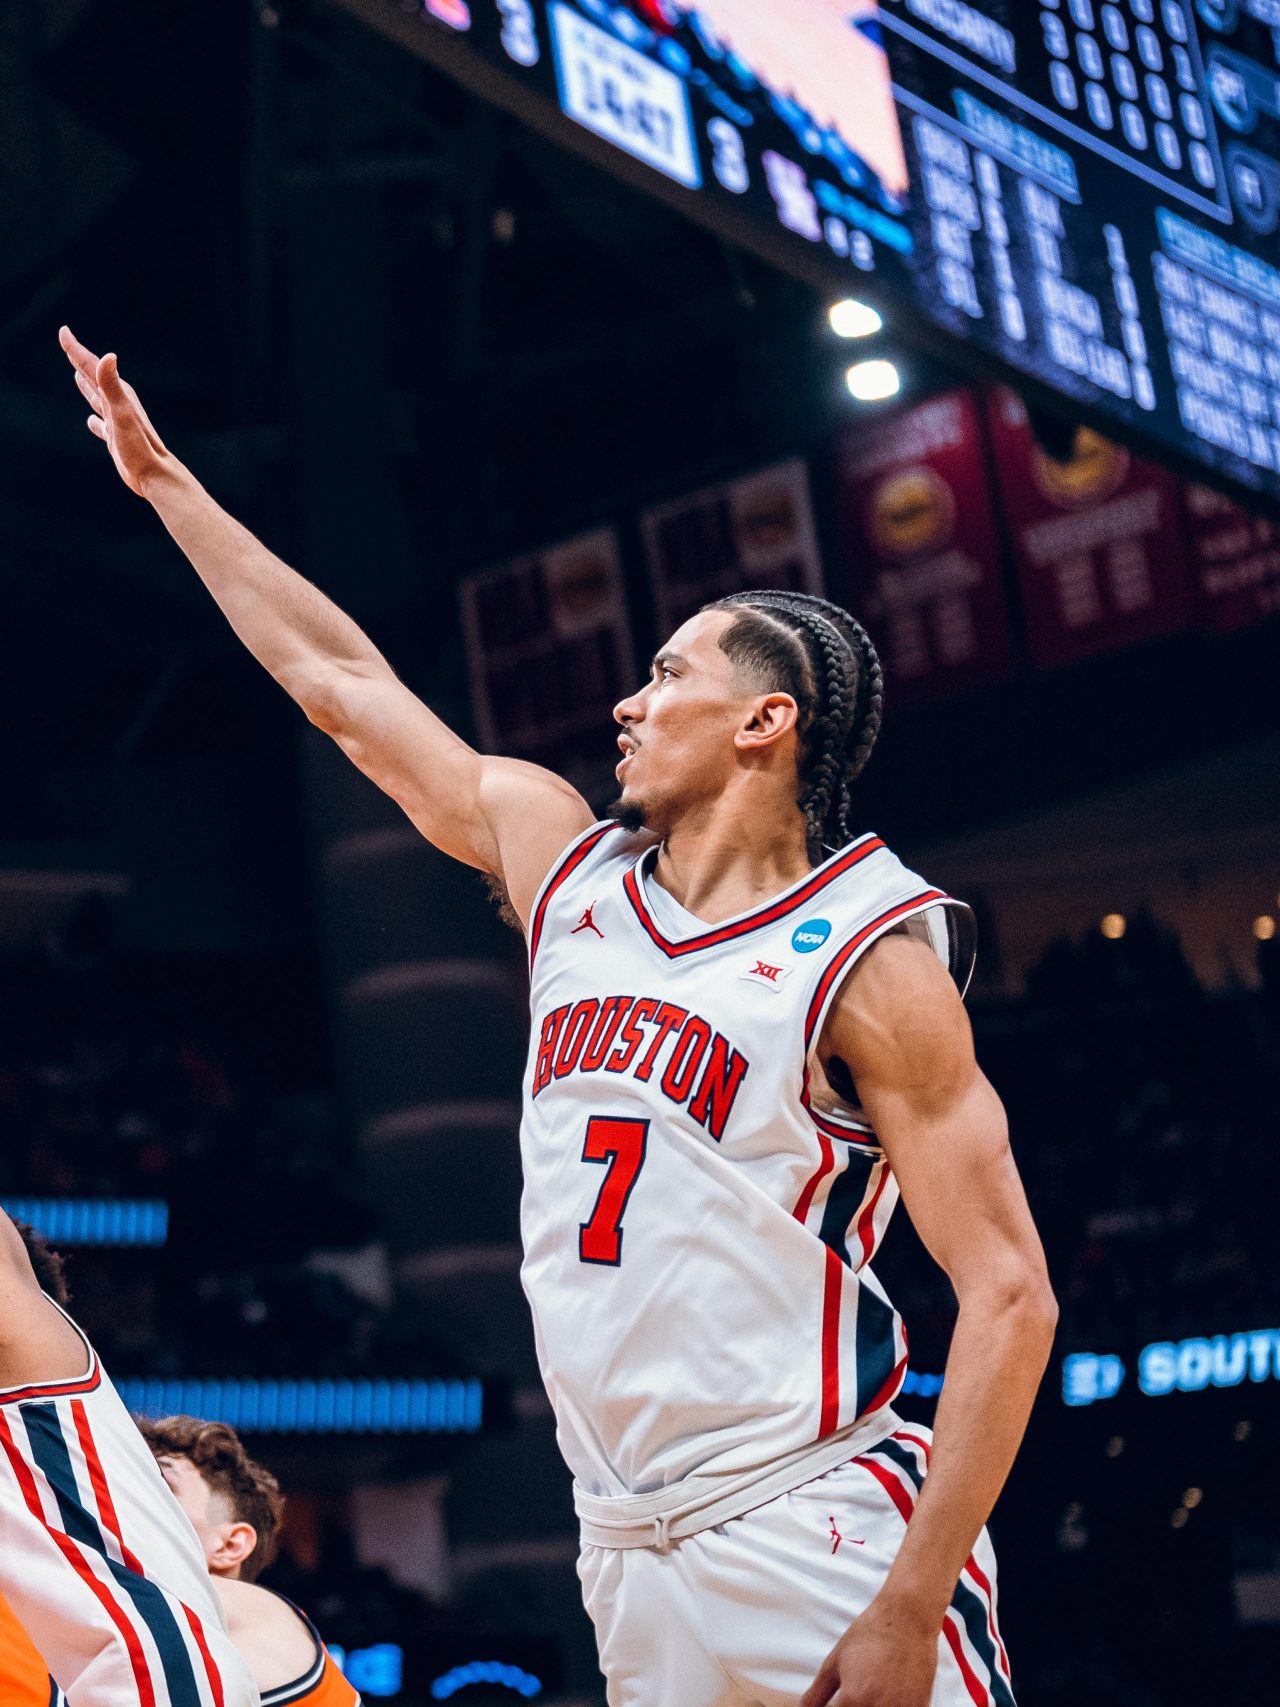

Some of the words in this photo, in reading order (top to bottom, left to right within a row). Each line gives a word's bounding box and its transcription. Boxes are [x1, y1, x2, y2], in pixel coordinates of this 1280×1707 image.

[794, 931, 824, 945] NCAA
[532, 995, 750, 1144] HOUSTON
[578, 1114, 651, 1268] 7
